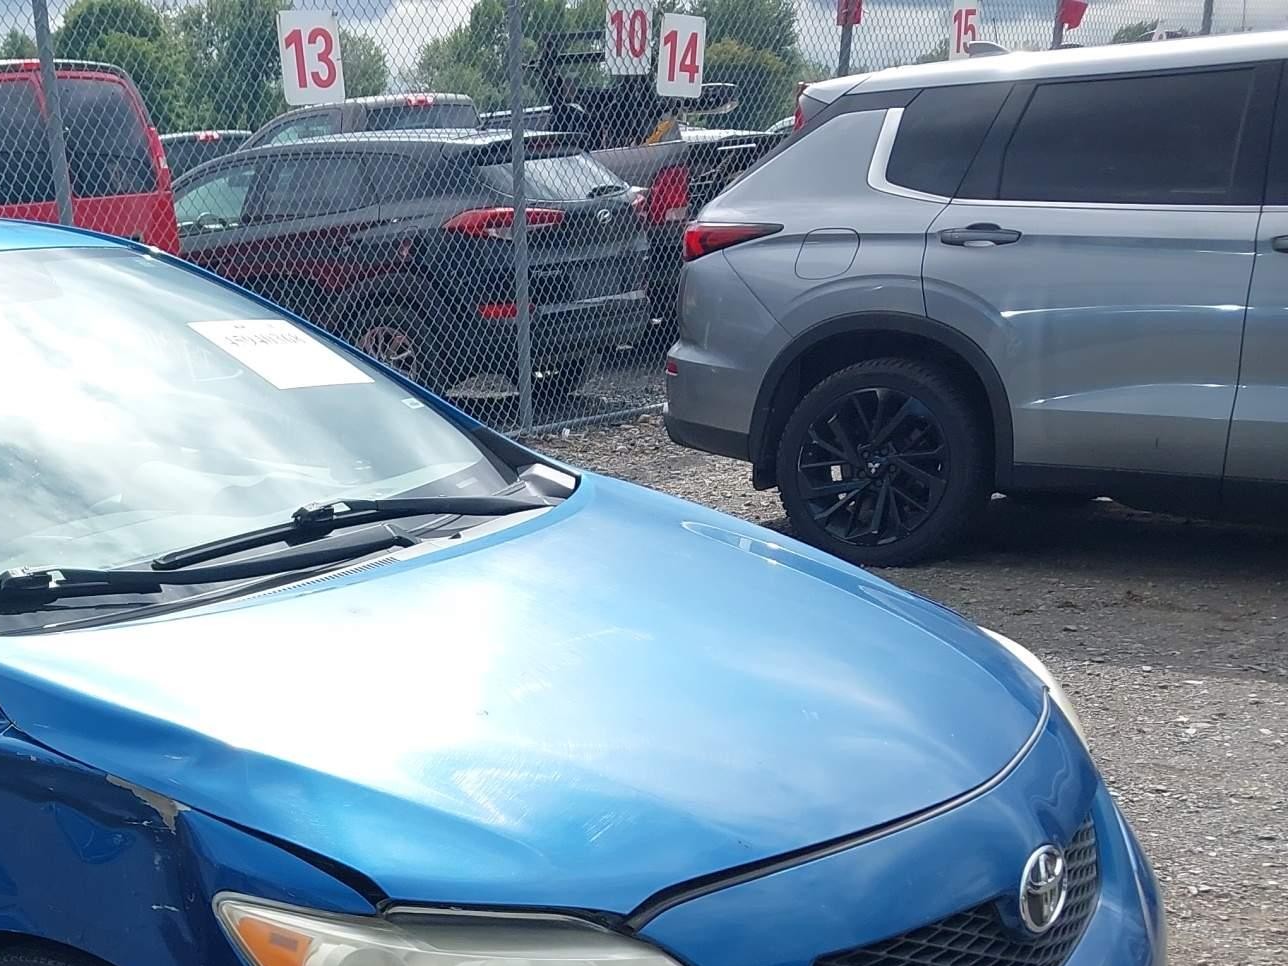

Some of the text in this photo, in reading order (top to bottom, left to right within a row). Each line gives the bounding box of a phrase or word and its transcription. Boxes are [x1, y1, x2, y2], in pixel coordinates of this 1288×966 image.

[611, 9, 647, 58] 10
[664, 30, 699, 83] 14
[953, 8, 977, 54] 15
[284, 27, 339, 88] 13
